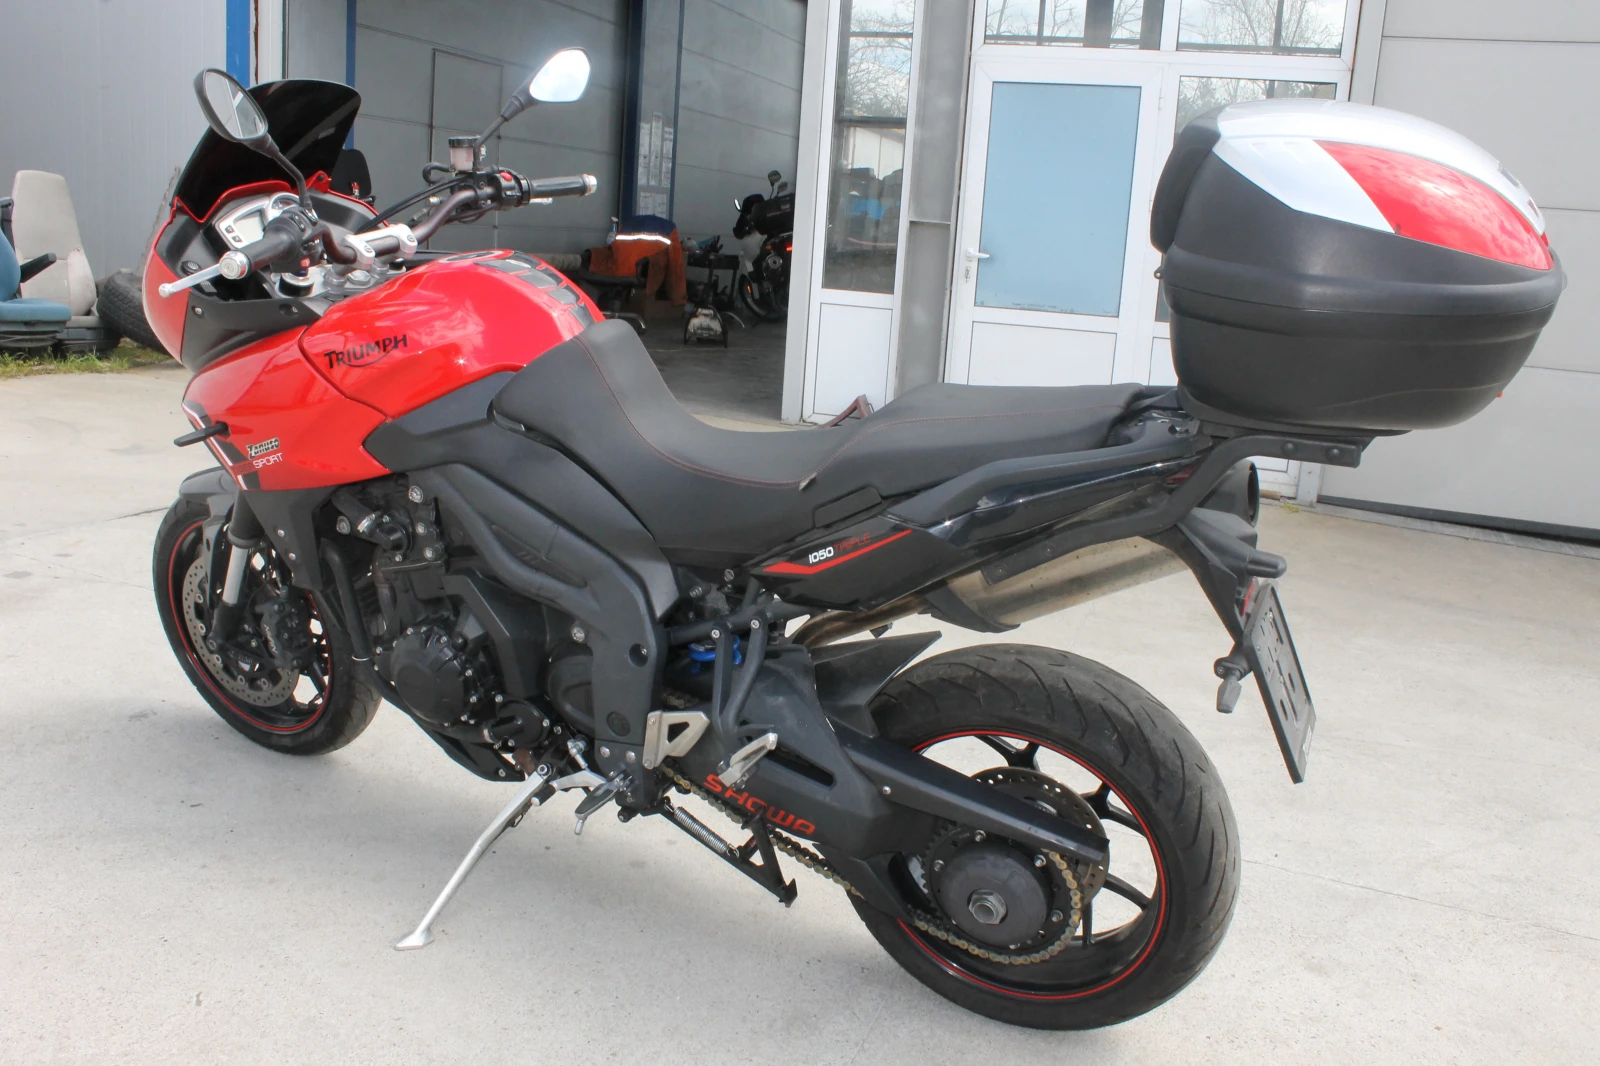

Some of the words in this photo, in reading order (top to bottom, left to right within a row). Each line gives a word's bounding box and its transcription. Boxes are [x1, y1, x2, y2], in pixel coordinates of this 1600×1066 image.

[323, 334, 408, 370] TRIUMPH
[252, 452, 283, 469] SPORT
[808, 546, 834, 564] 1050
[834, 532, 871, 553] TRIPLE
[702, 773, 817, 836] SHOWA
